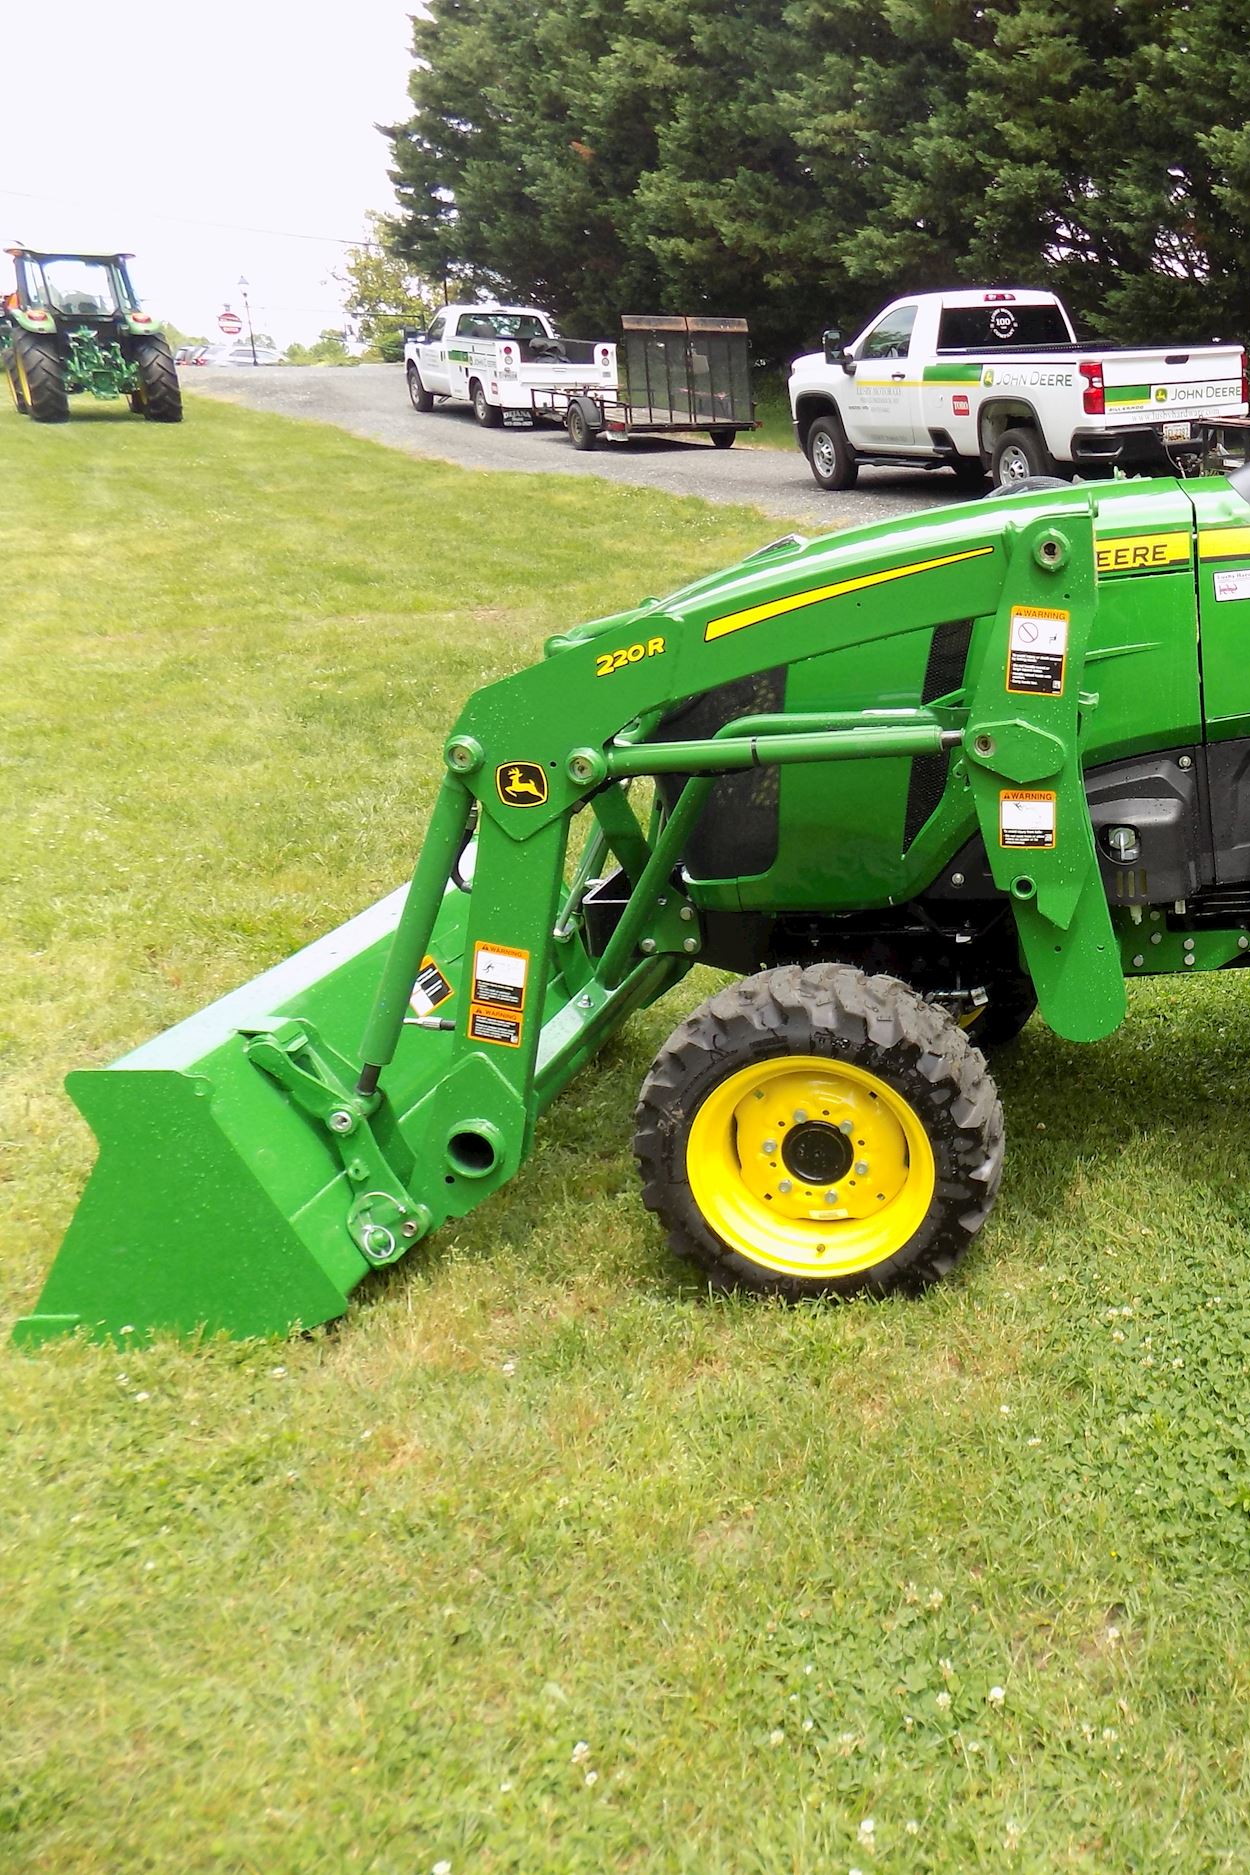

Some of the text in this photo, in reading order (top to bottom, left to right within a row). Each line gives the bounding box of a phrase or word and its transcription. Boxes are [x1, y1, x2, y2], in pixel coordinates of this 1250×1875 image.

[995, 317, 1011, 326] 100
[996, 371, 1073, 387] JOHN DEERE
[1171, 385, 1241, 401] JOHN DEERE
[1097, 544, 1168, 567] EERE
[1024, 610, 1066, 620] WARNING
[1011, 792, 1052, 800] WARNING
[490, 946, 523, 958] WARNING
[484, 1009, 517, 1021] WARNING
